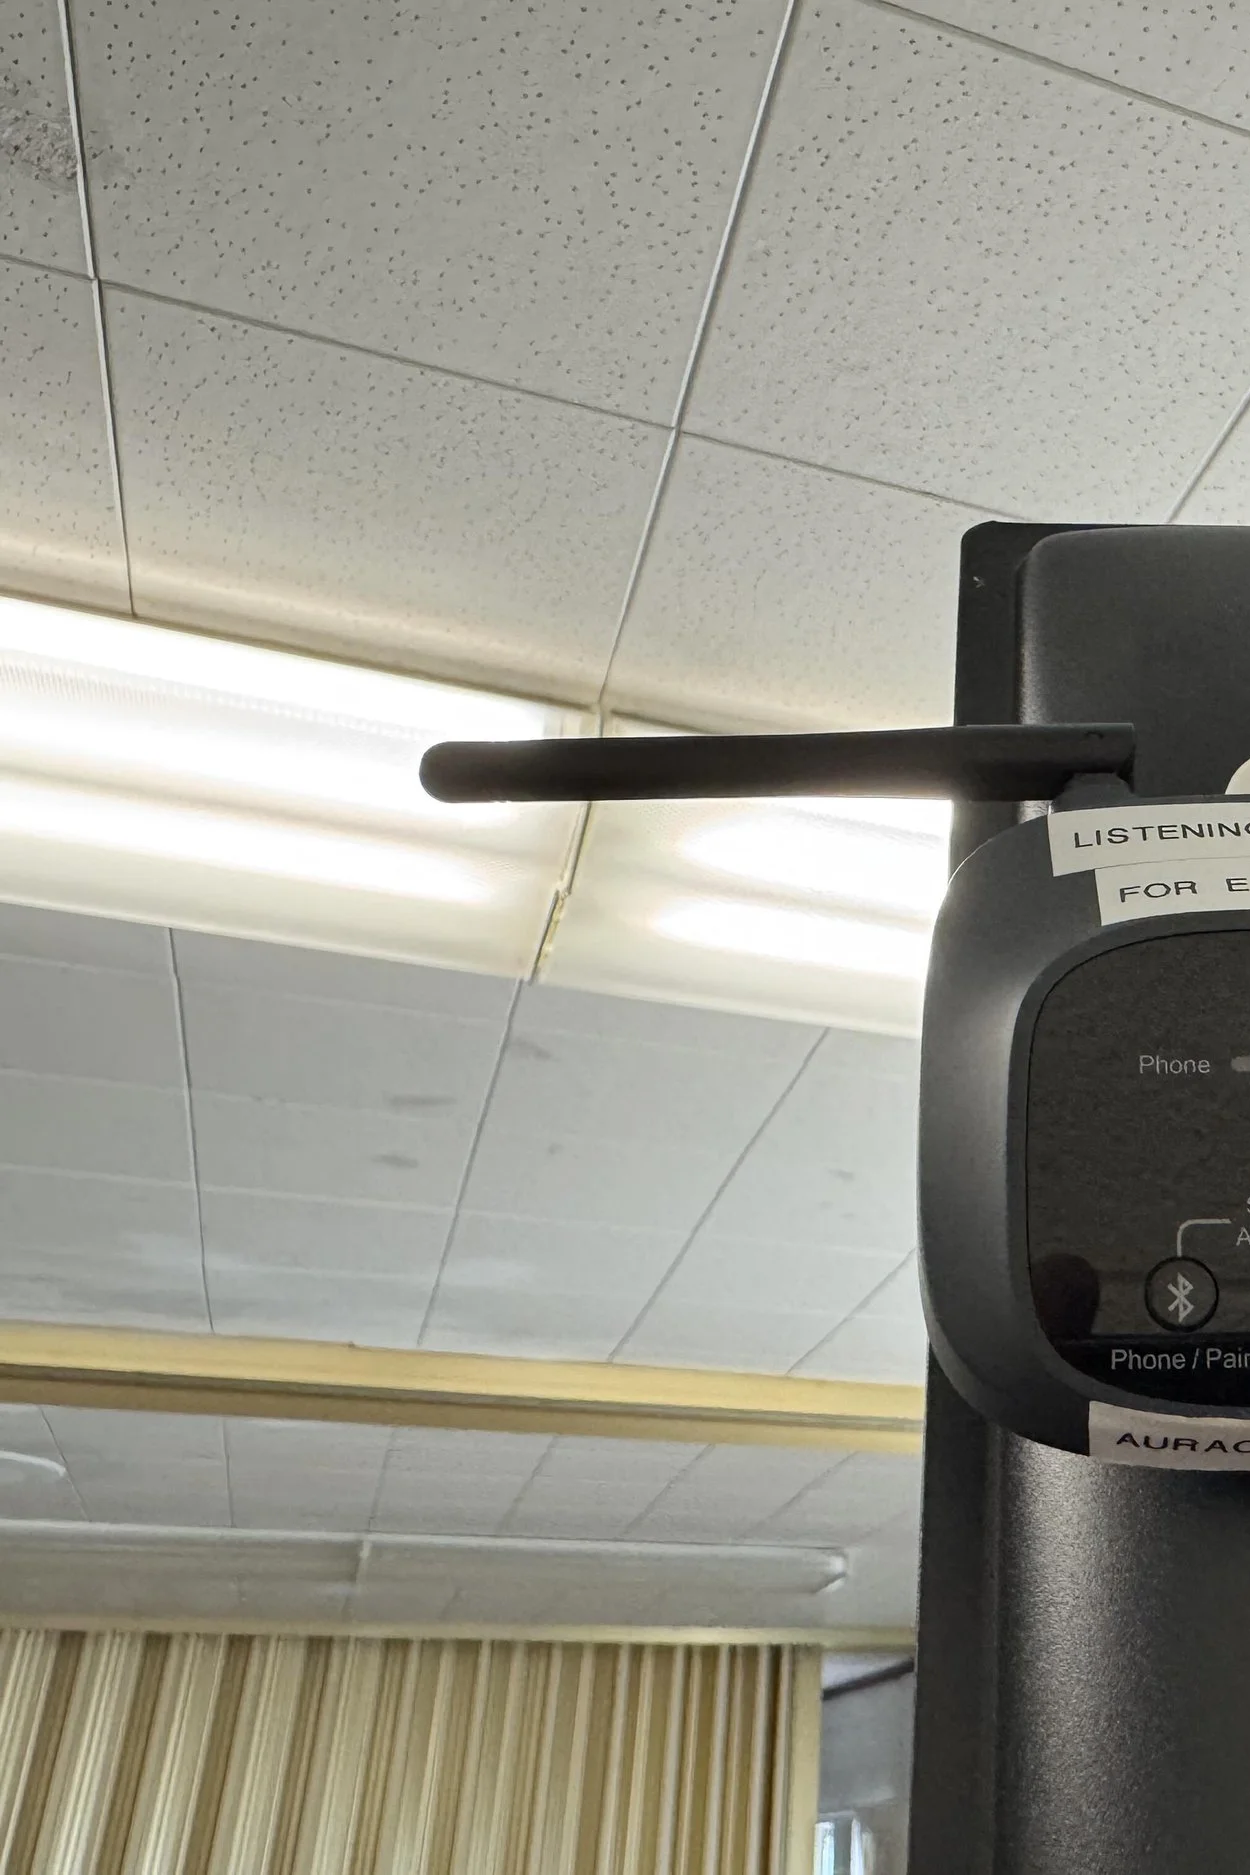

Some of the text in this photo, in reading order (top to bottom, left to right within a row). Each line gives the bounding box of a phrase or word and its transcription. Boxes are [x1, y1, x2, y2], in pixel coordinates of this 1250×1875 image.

[1118, 880, 1199, 903] FOR
[1138, 1054, 1211, 1075] Phone
[1110, 1348, 1187, 1370] Phone
